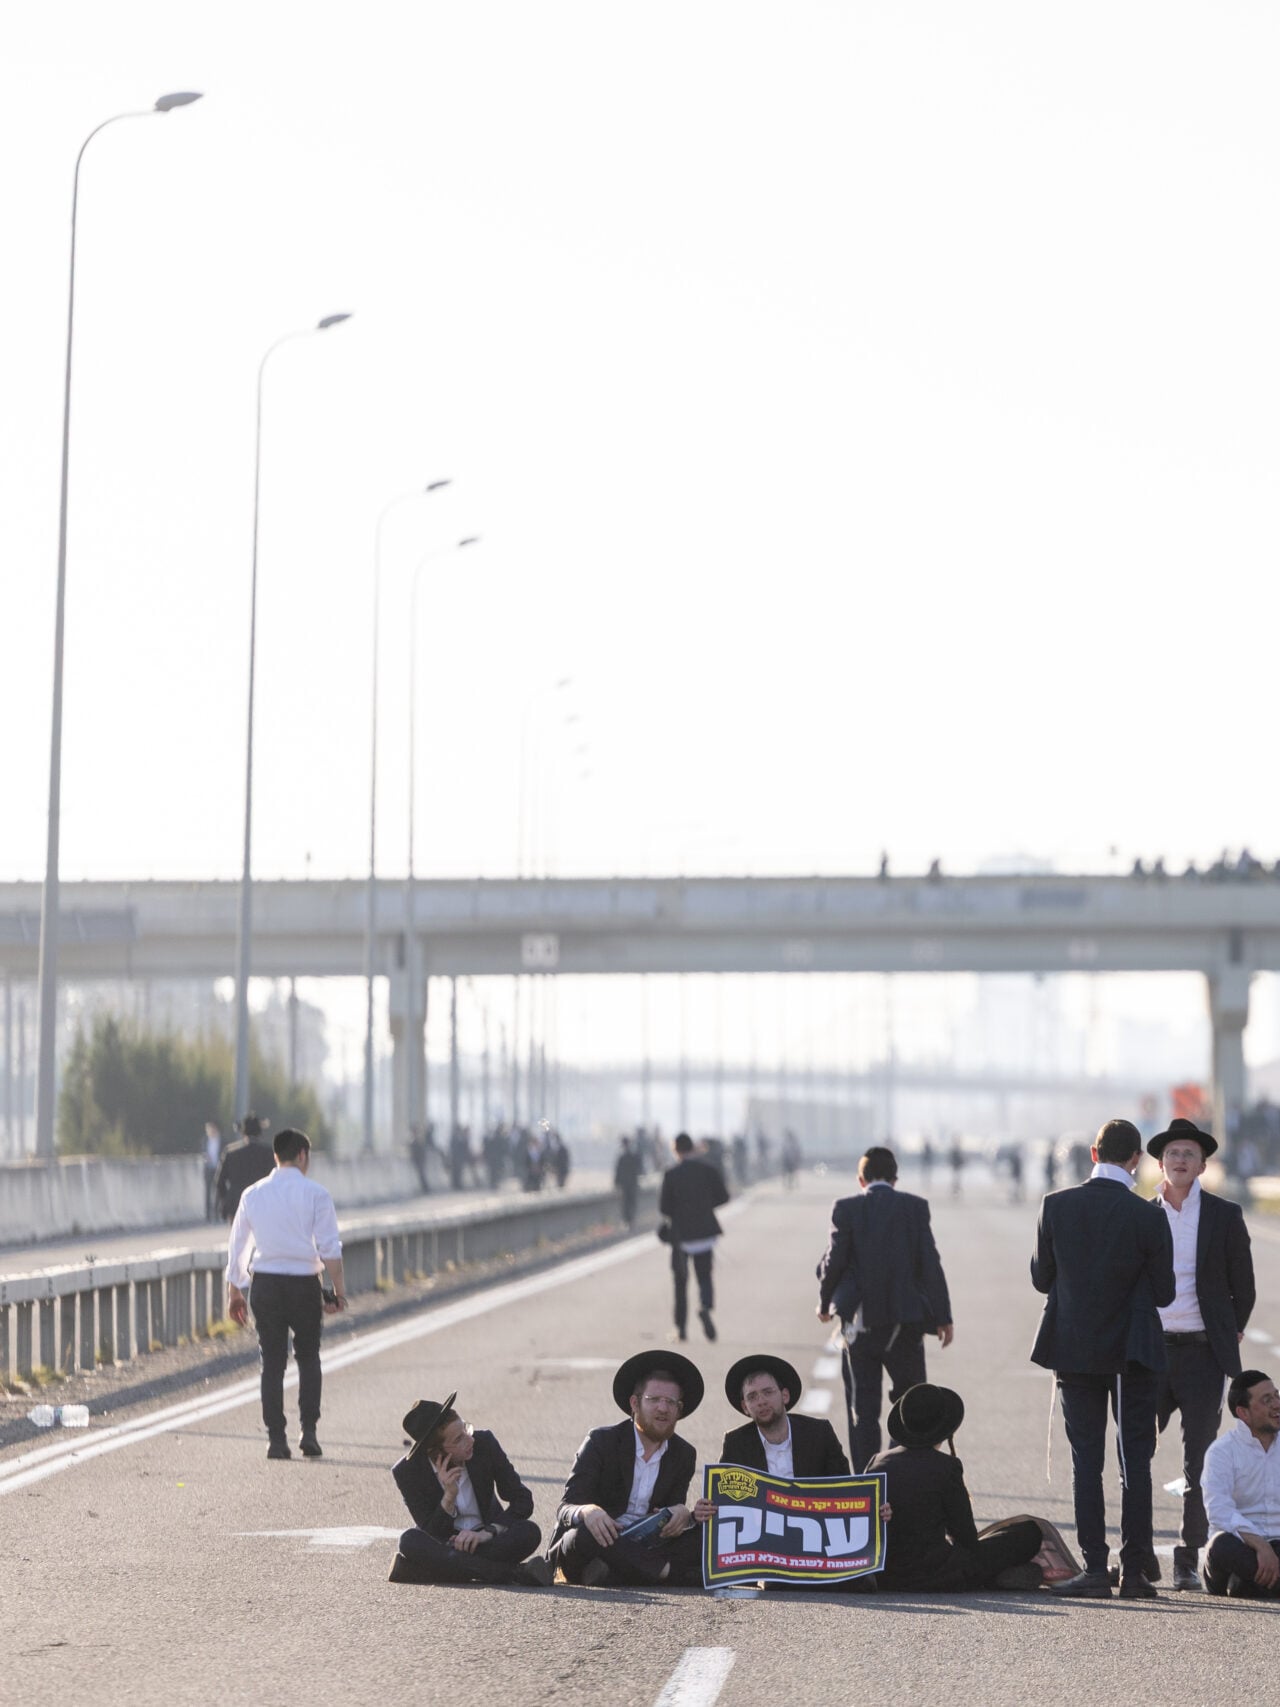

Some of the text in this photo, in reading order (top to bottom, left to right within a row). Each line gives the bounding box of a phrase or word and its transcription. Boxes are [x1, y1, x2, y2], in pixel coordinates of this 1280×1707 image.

[771, 1494, 866, 1510] שוטר יקר, גם אני
[718, 1505, 869, 1557] עריק
[721, 1553, 868, 1569] ואשמח לשבת בכלא הצבאי
